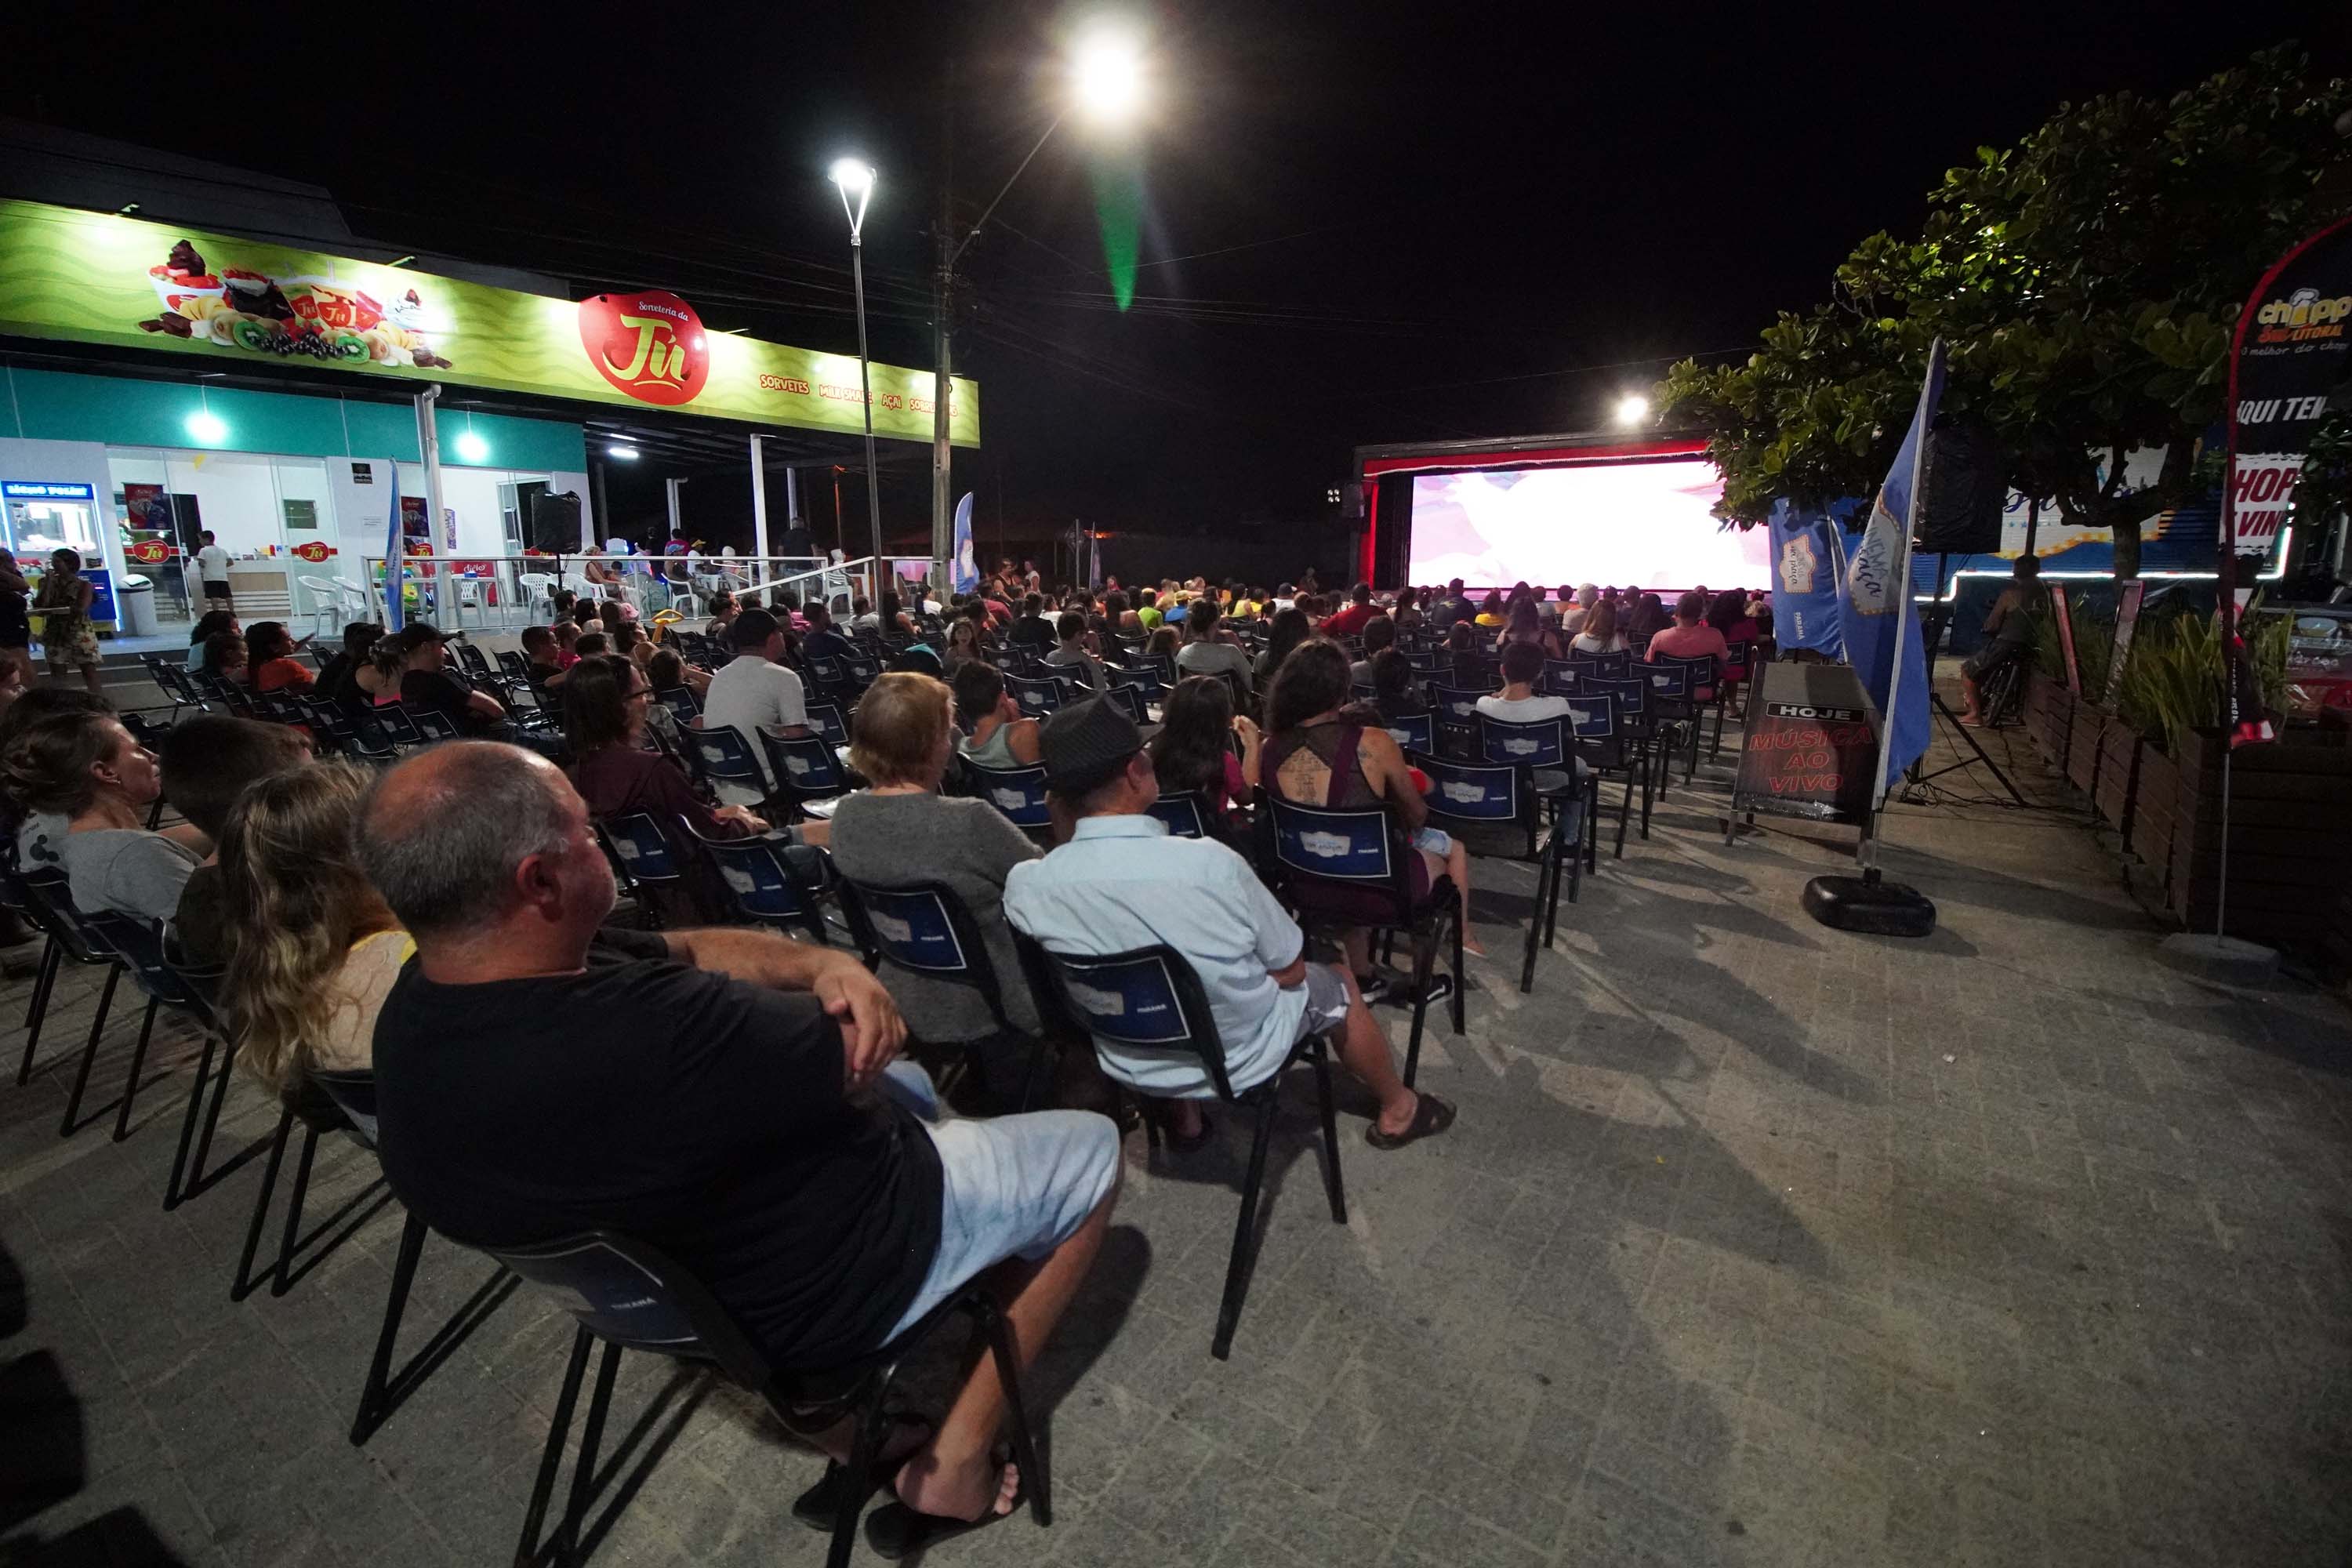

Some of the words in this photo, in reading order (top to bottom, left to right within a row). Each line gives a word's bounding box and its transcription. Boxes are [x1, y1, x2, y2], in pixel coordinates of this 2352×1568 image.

[639, 300, 677, 317] Sorveteria
[677, 311, 689, 321] da
[2249, 343, 2290, 356] melhor
[759, 374, 810, 394] SORVETES
[844, 388, 873, 404] SHAE
[1780, 705, 1852, 720] HOJE
[1748, 727, 1873, 752] MÚSICA
[1786, 752, 1831, 770] AO
[1769, 773, 1844, 793] VIVO
